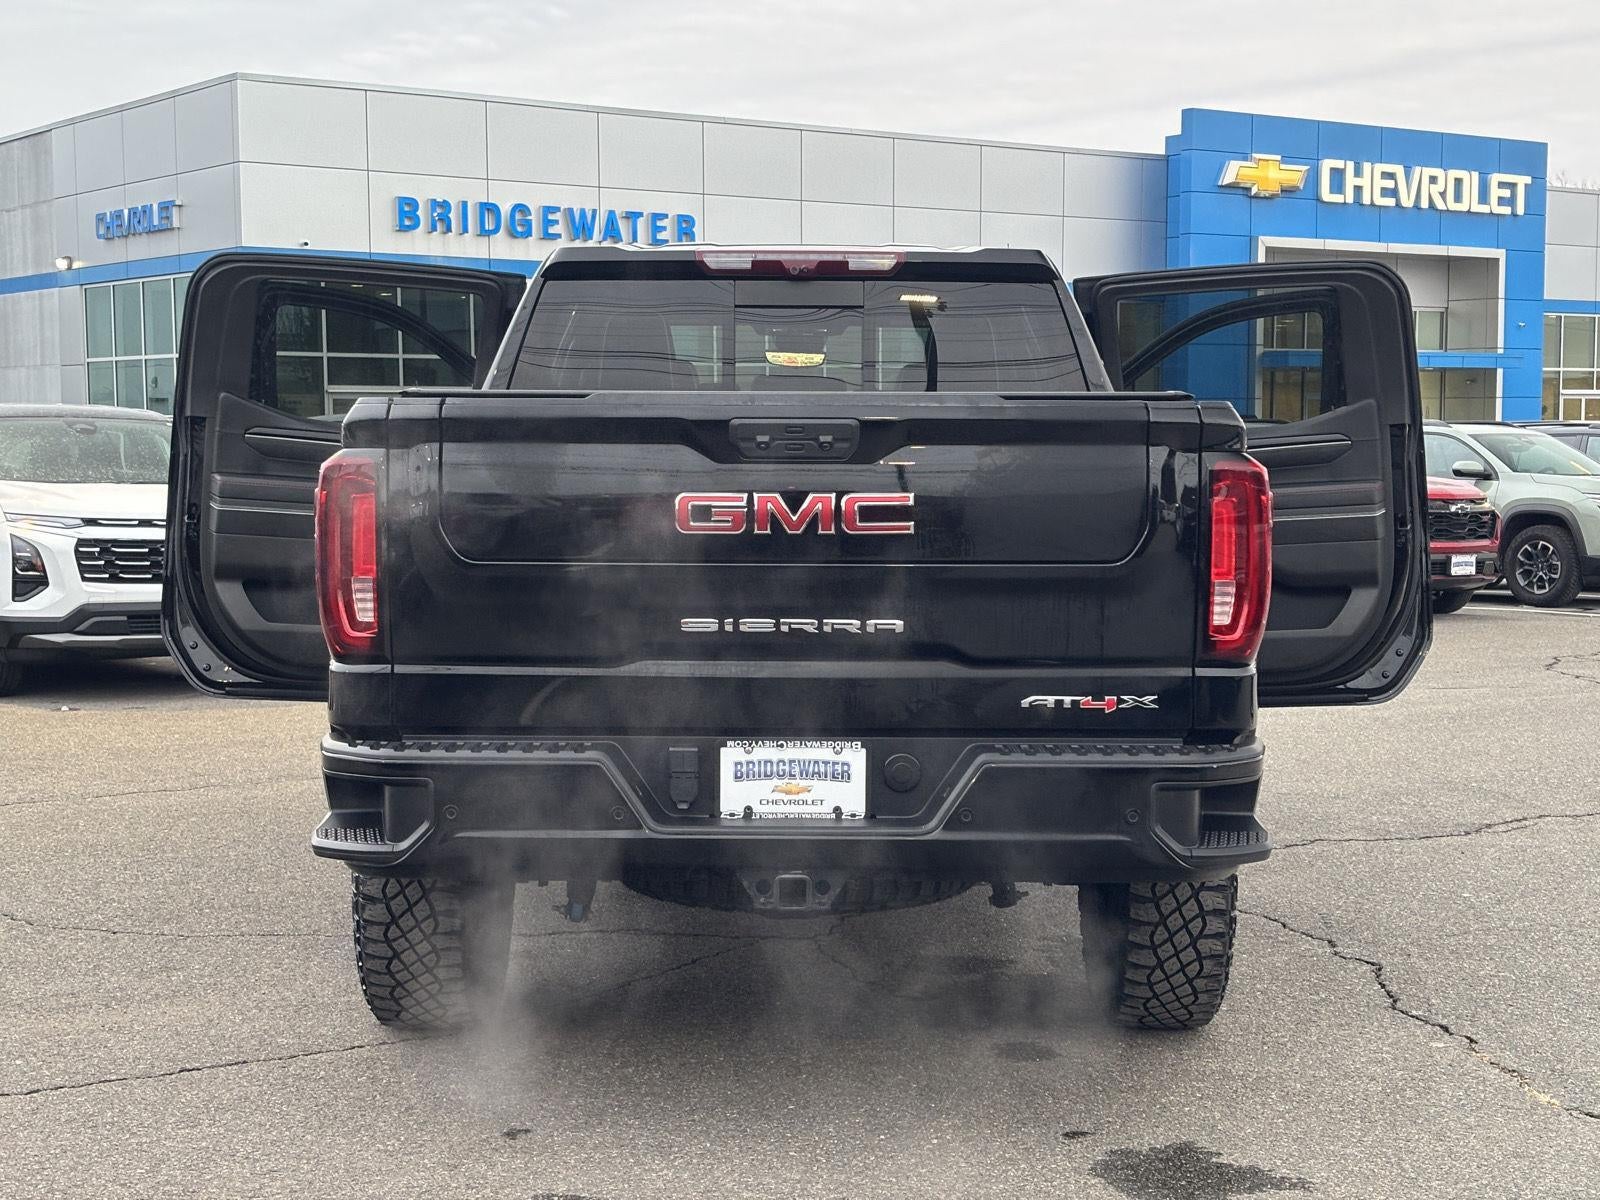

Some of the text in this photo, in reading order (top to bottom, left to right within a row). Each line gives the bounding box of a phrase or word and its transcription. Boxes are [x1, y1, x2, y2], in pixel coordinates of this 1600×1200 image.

[1319, 158, 1532, 216] CHEVROLET
[95, 200, 180, 240] CHEVROLET
[394, 196, 697, 245] BRIDGEWATER
[675, 492, 914, 534] GMC
[680, 618, 905, 633] SIERRA
[1020, 695, 1159, 713] AT4X
[734, 758, 852, 783] BRIDGEWATER
